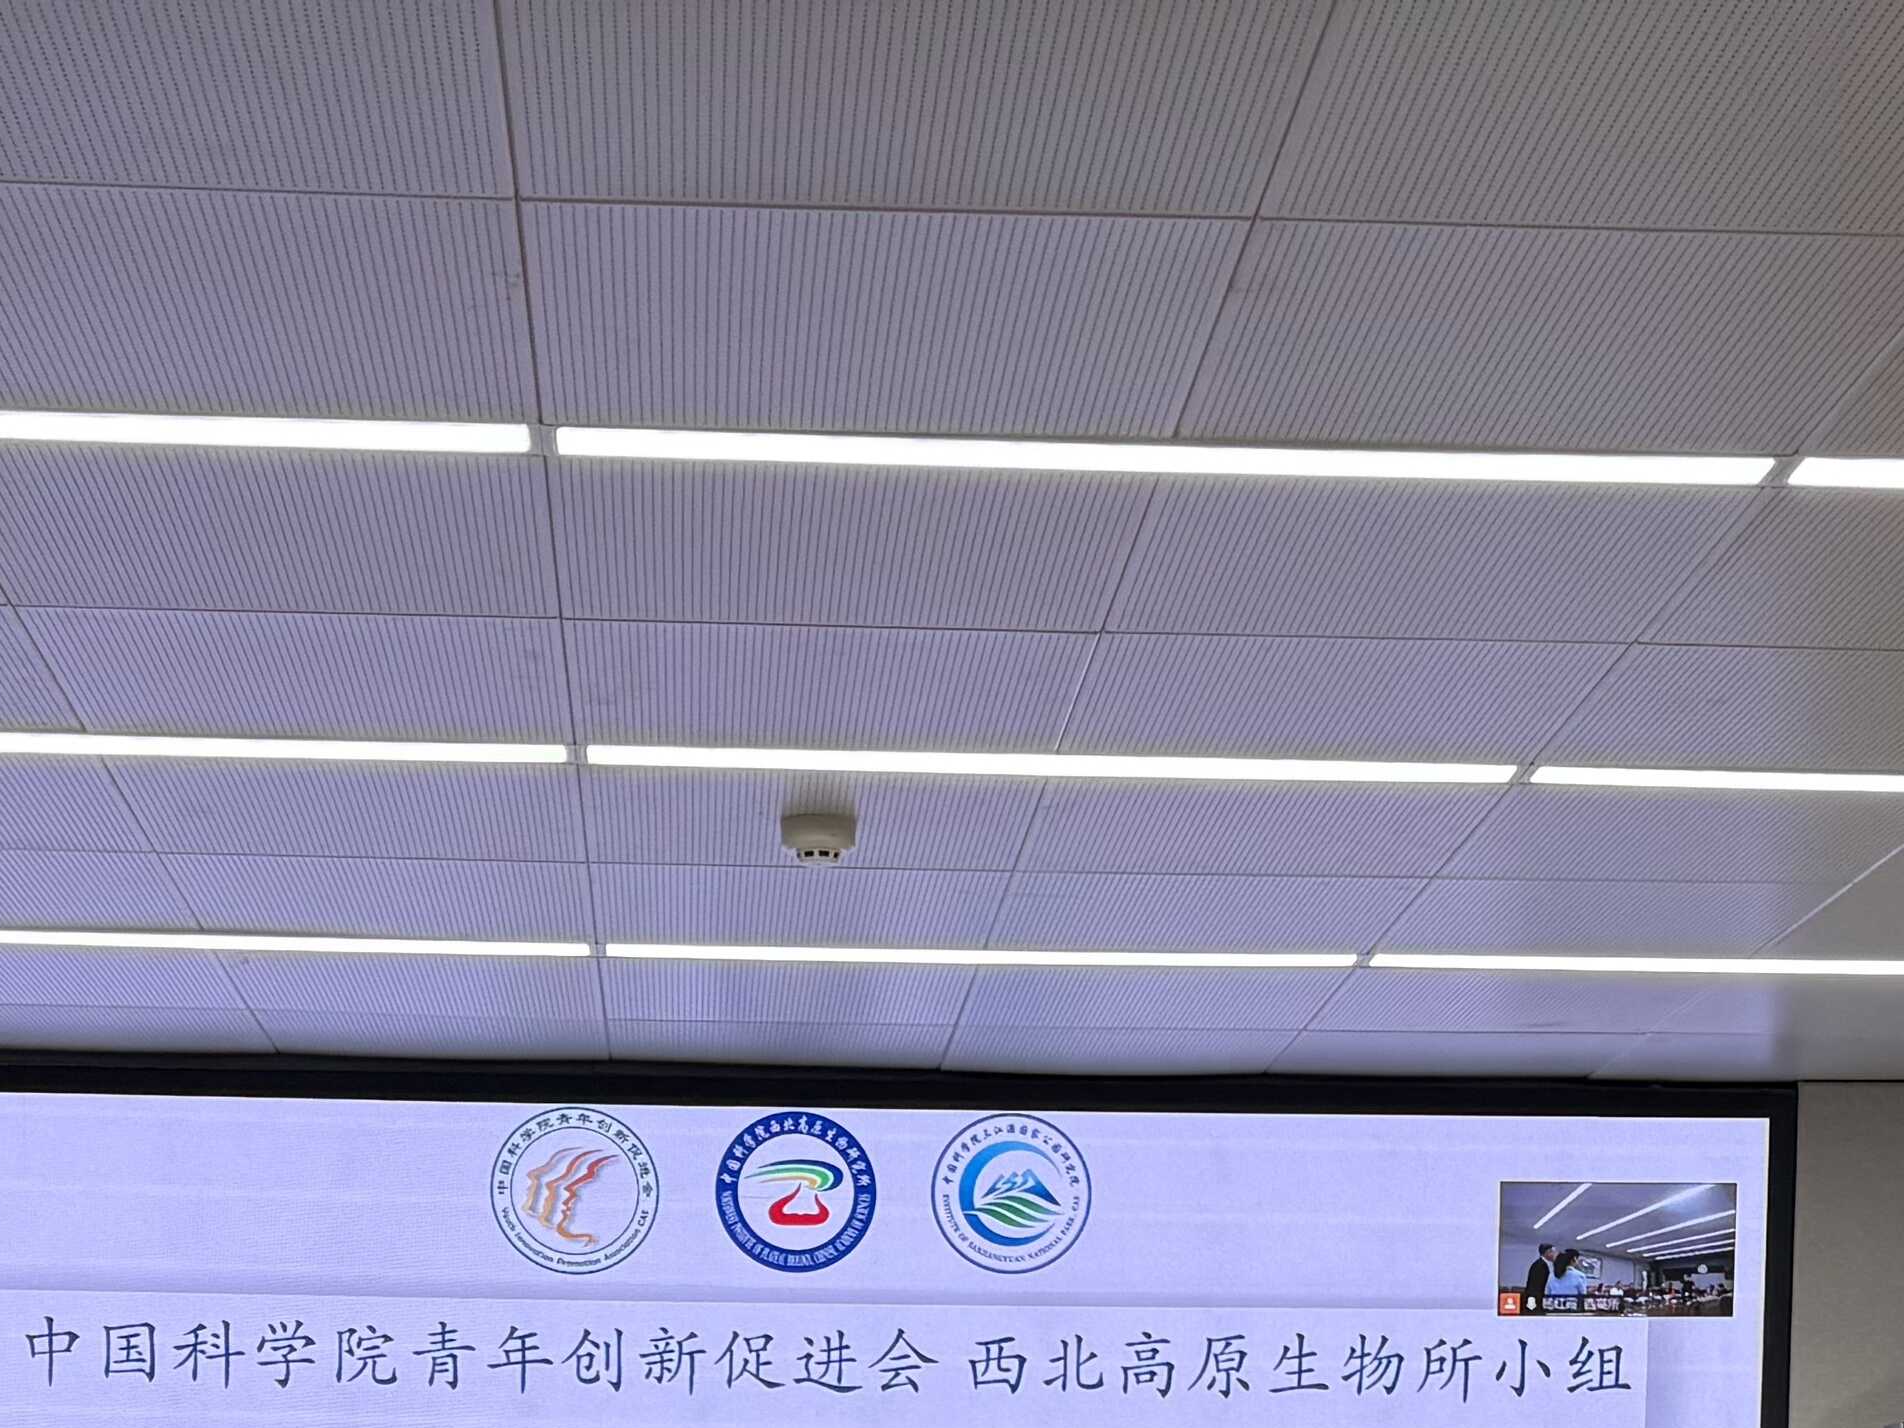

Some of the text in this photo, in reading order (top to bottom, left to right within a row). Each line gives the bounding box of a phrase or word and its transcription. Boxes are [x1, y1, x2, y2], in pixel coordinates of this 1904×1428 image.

[27, 1317, 1630, 1400] 中国科学院青年创新促进会 西北高原生物所小组
